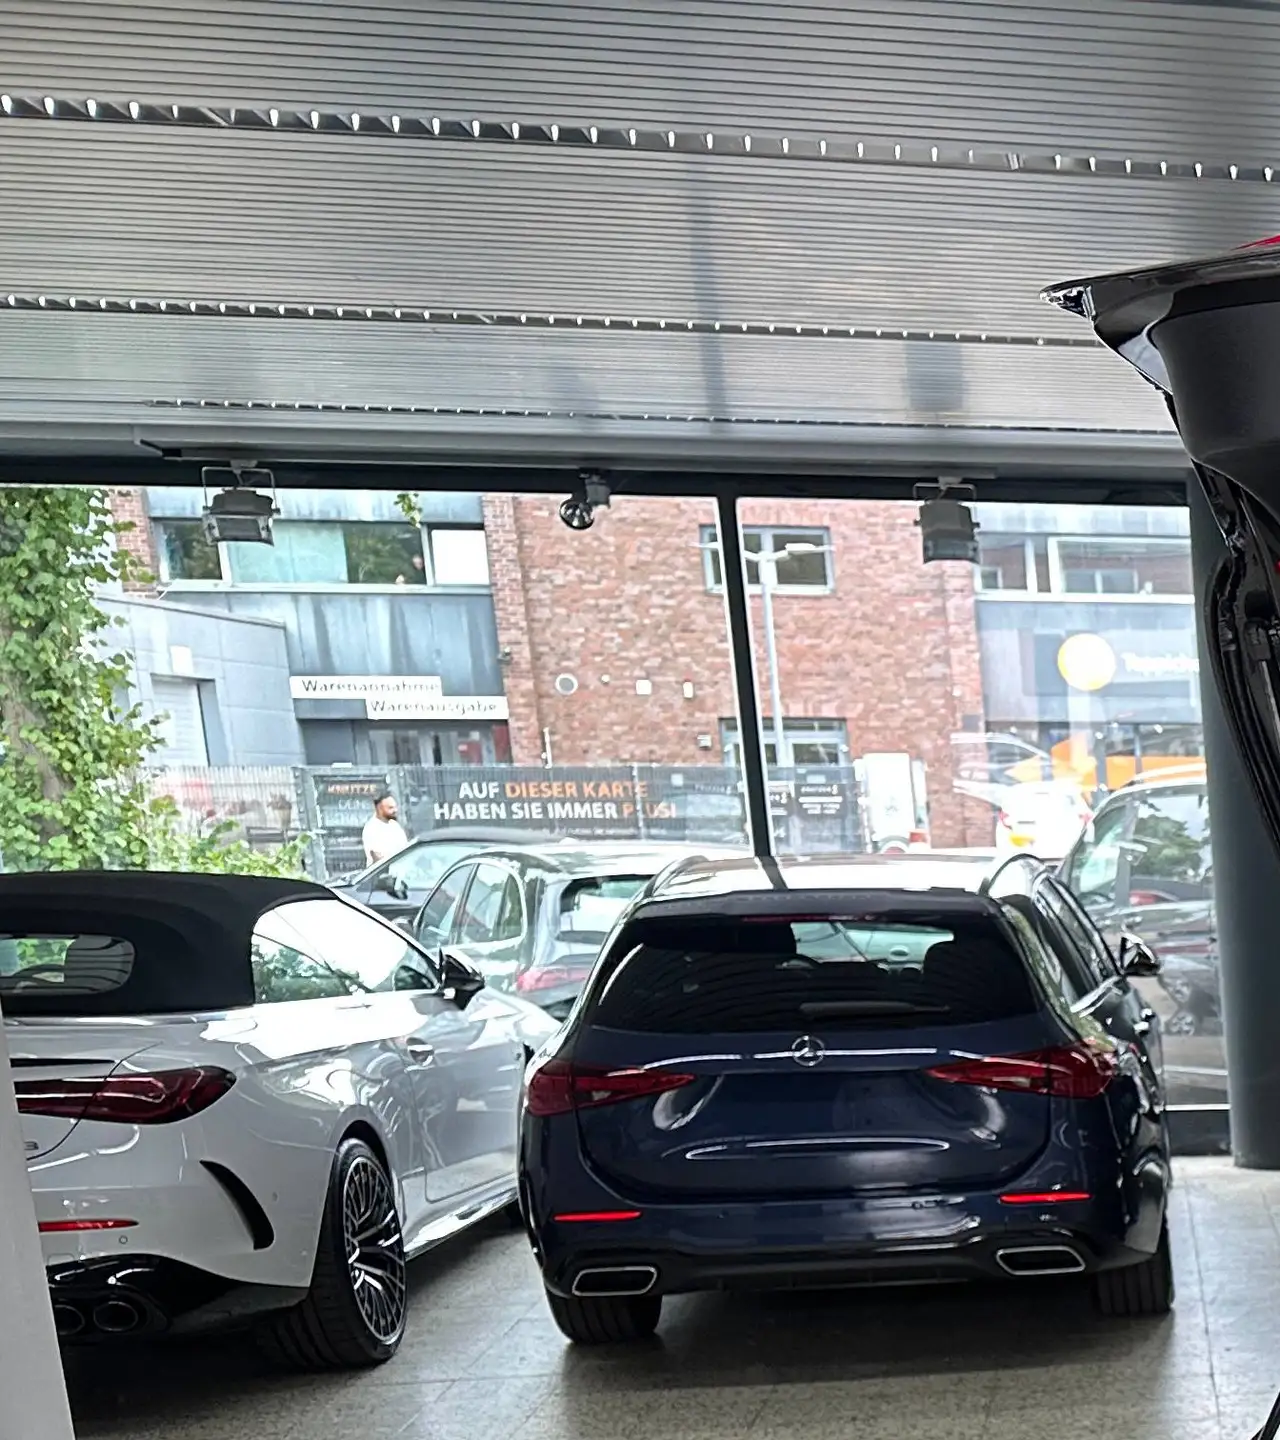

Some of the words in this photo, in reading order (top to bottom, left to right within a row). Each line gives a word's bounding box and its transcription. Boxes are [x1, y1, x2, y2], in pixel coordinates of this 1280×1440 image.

[459, 782, 500, 799] AUF
[505, 782, 578, 798] DIESER
[583, 782, 648, 797] KARTE
[434, 802, 507, 819] HABEN
[511, 803, 544, 819] SIE
[547, 803, 618, 819] IMMER
